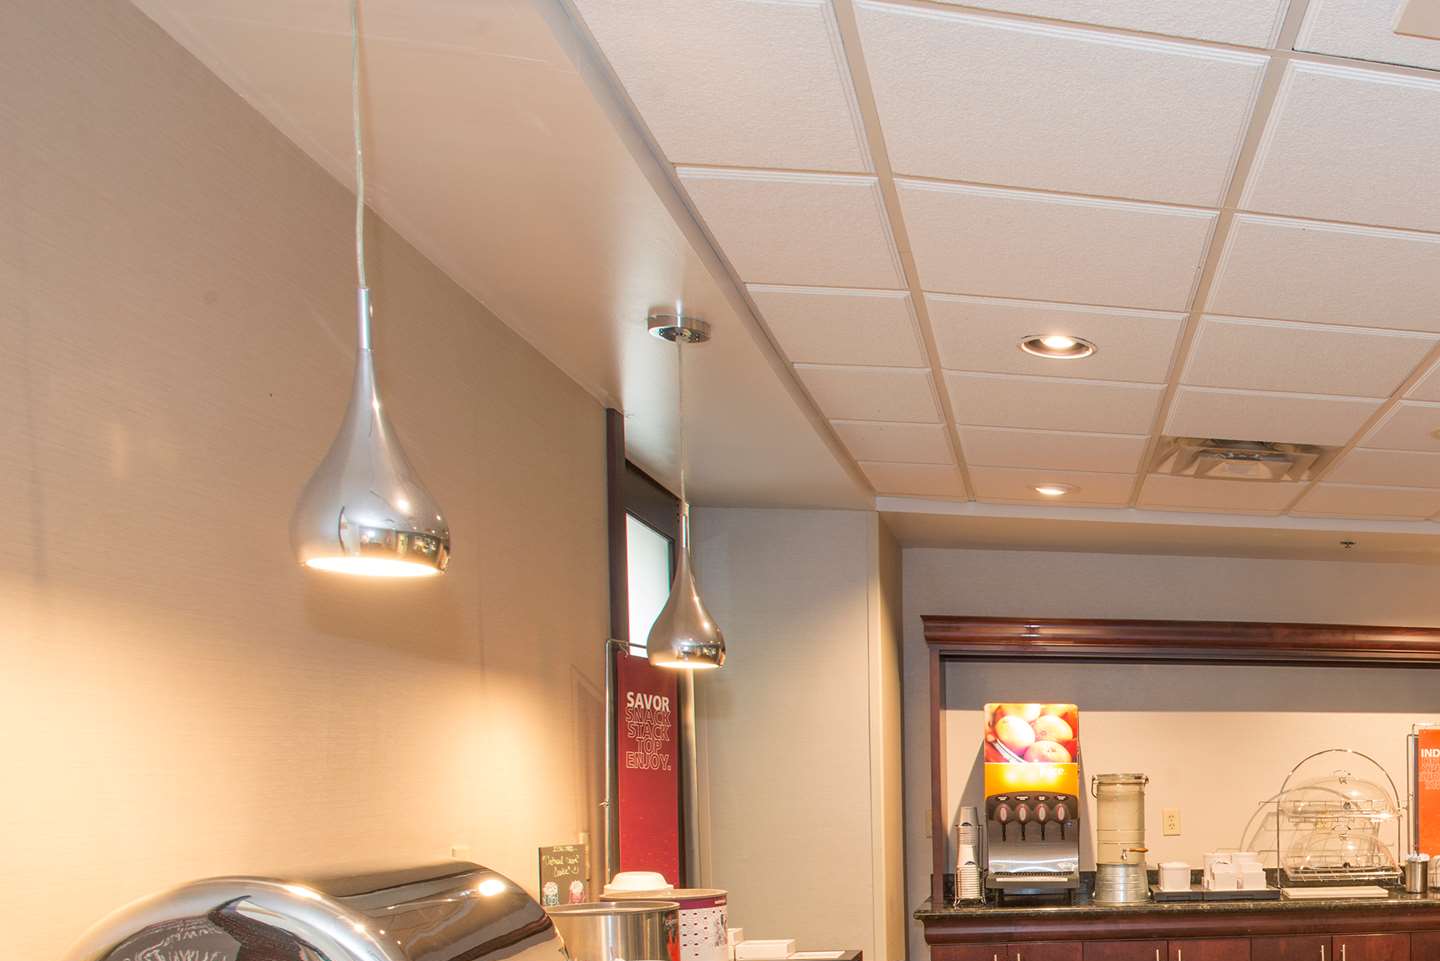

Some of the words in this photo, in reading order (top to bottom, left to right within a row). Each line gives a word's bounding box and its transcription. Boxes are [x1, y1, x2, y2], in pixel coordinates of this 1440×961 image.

[626, 691, 670, 712] SAVOR
[625, 707, 671, 727] SNACK
[627, 721, 671, 741] STACK
[636, 737, 662, 754] TOP
[625, 751, 671, 770] ENJOY.
